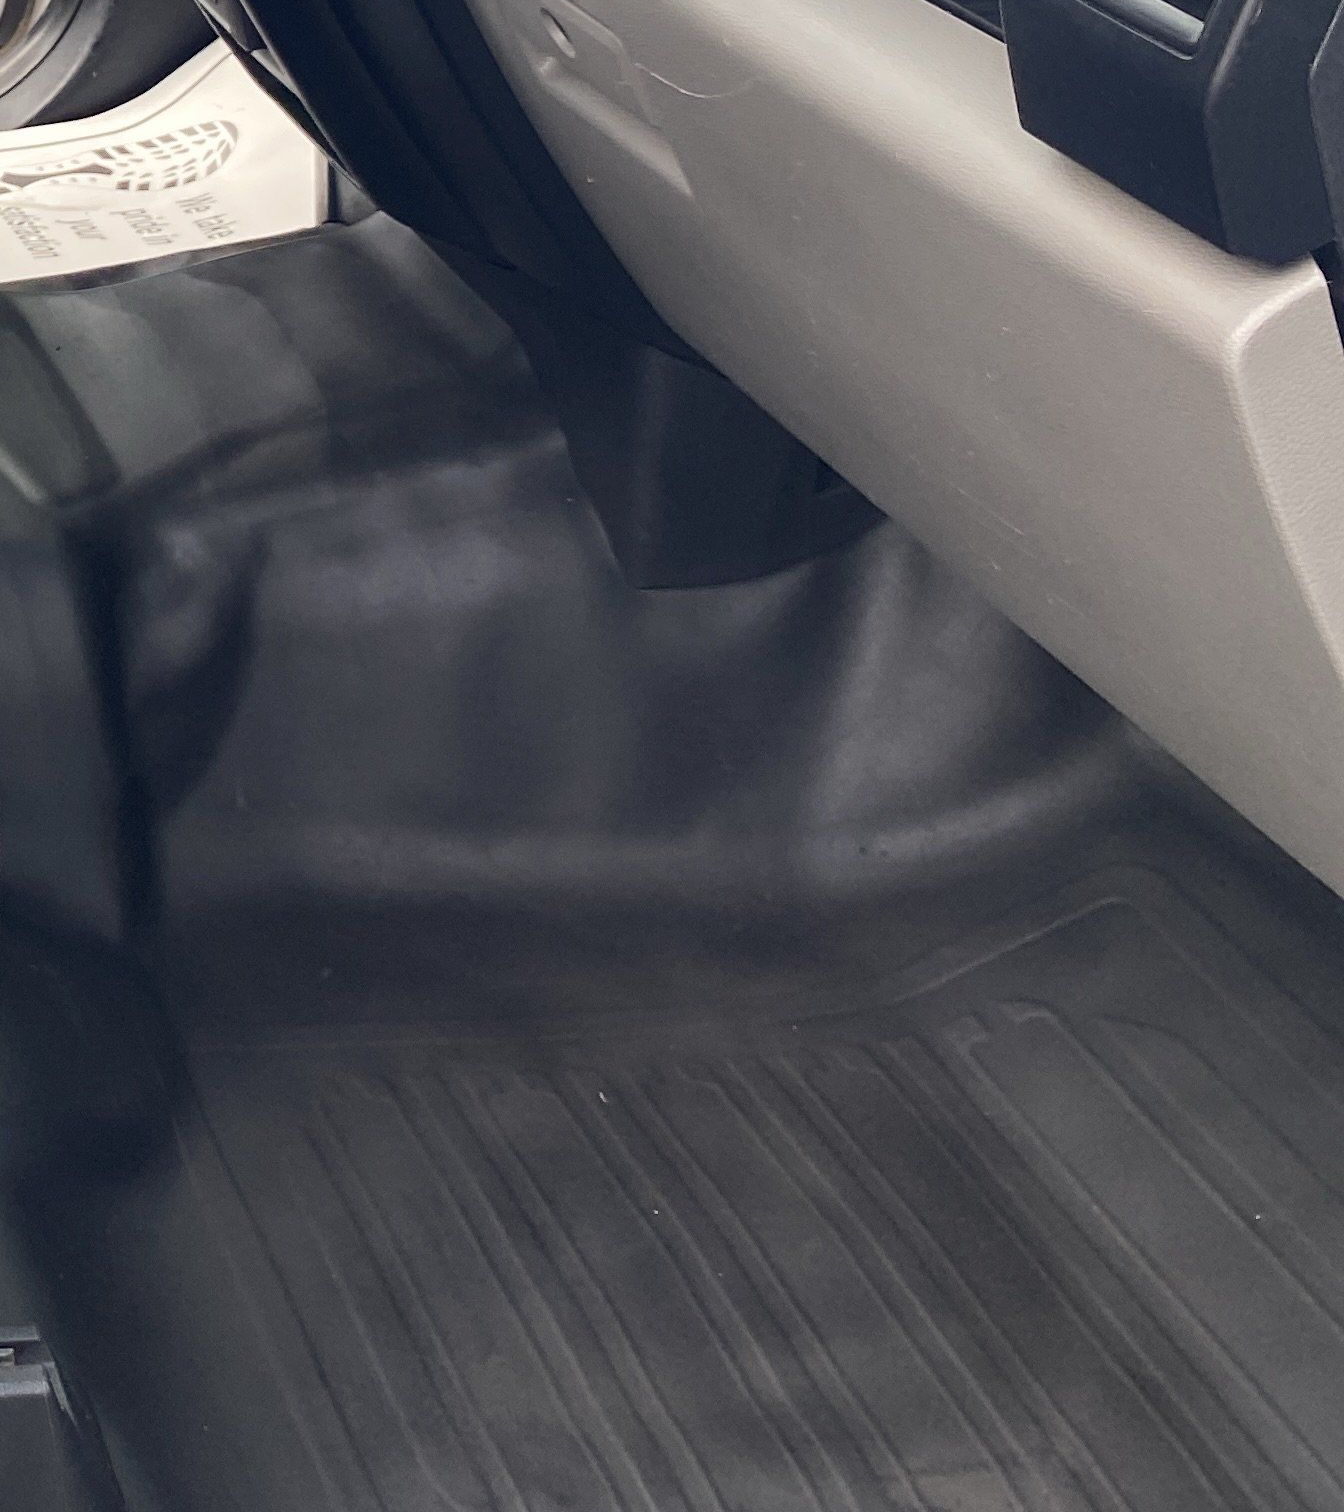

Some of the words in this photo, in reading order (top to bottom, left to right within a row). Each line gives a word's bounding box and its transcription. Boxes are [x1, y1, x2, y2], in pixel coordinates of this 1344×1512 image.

[175, 192, 217, 214] We
[54, 218, 107, 239] your
[109, 208, 171, 234] pride
[141, 233, 179, 245] in
[193, 213, 237, 239] take
